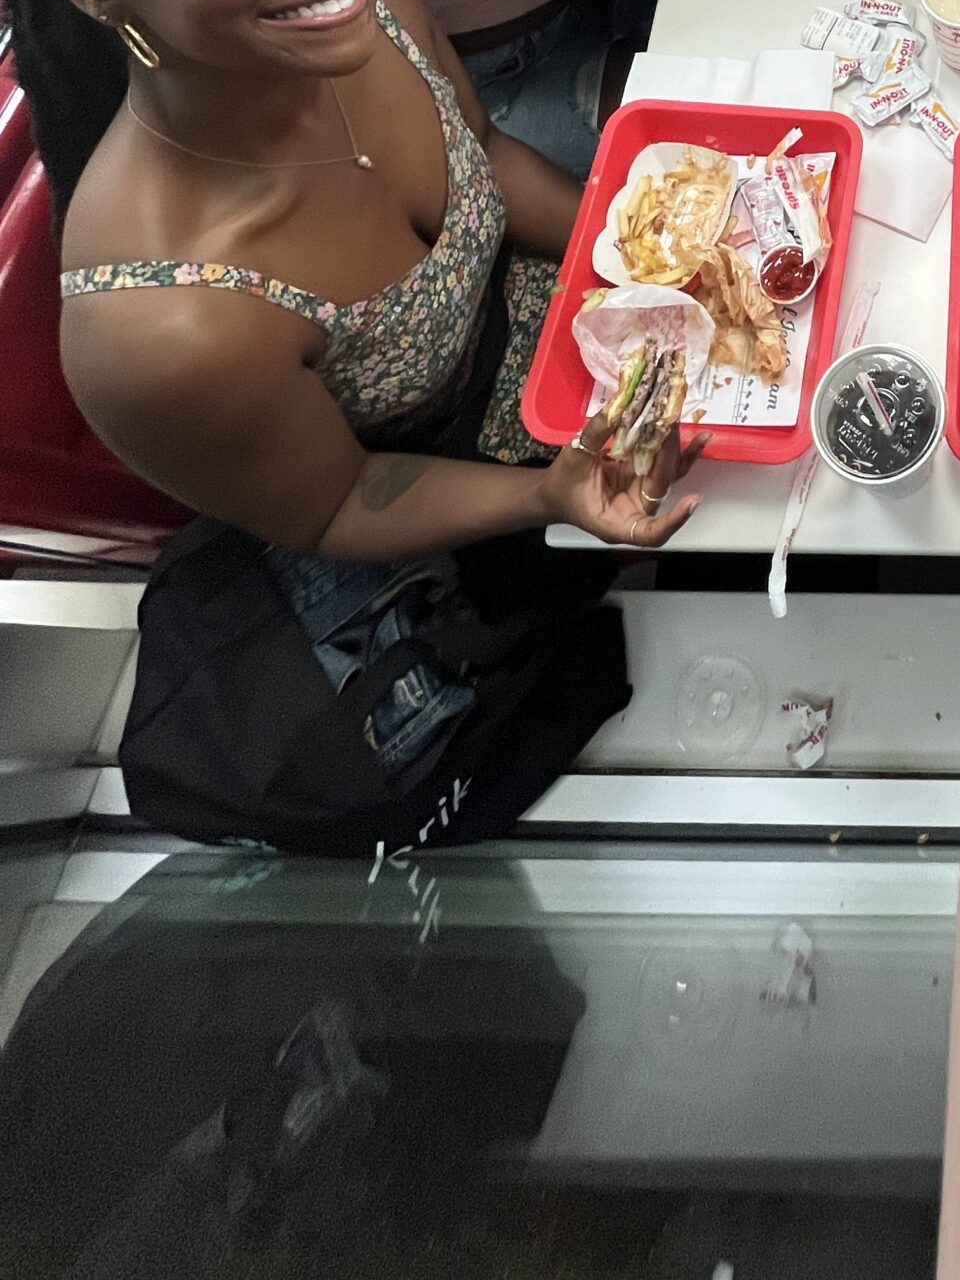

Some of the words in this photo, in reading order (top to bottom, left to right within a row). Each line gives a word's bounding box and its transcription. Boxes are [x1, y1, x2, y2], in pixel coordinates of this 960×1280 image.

[860, 0, 902, 13] IN-N-OUT
[869, 86, 910, 110] IN-N-OUT
[919, 105, 955, 138] IN-N-OUT
